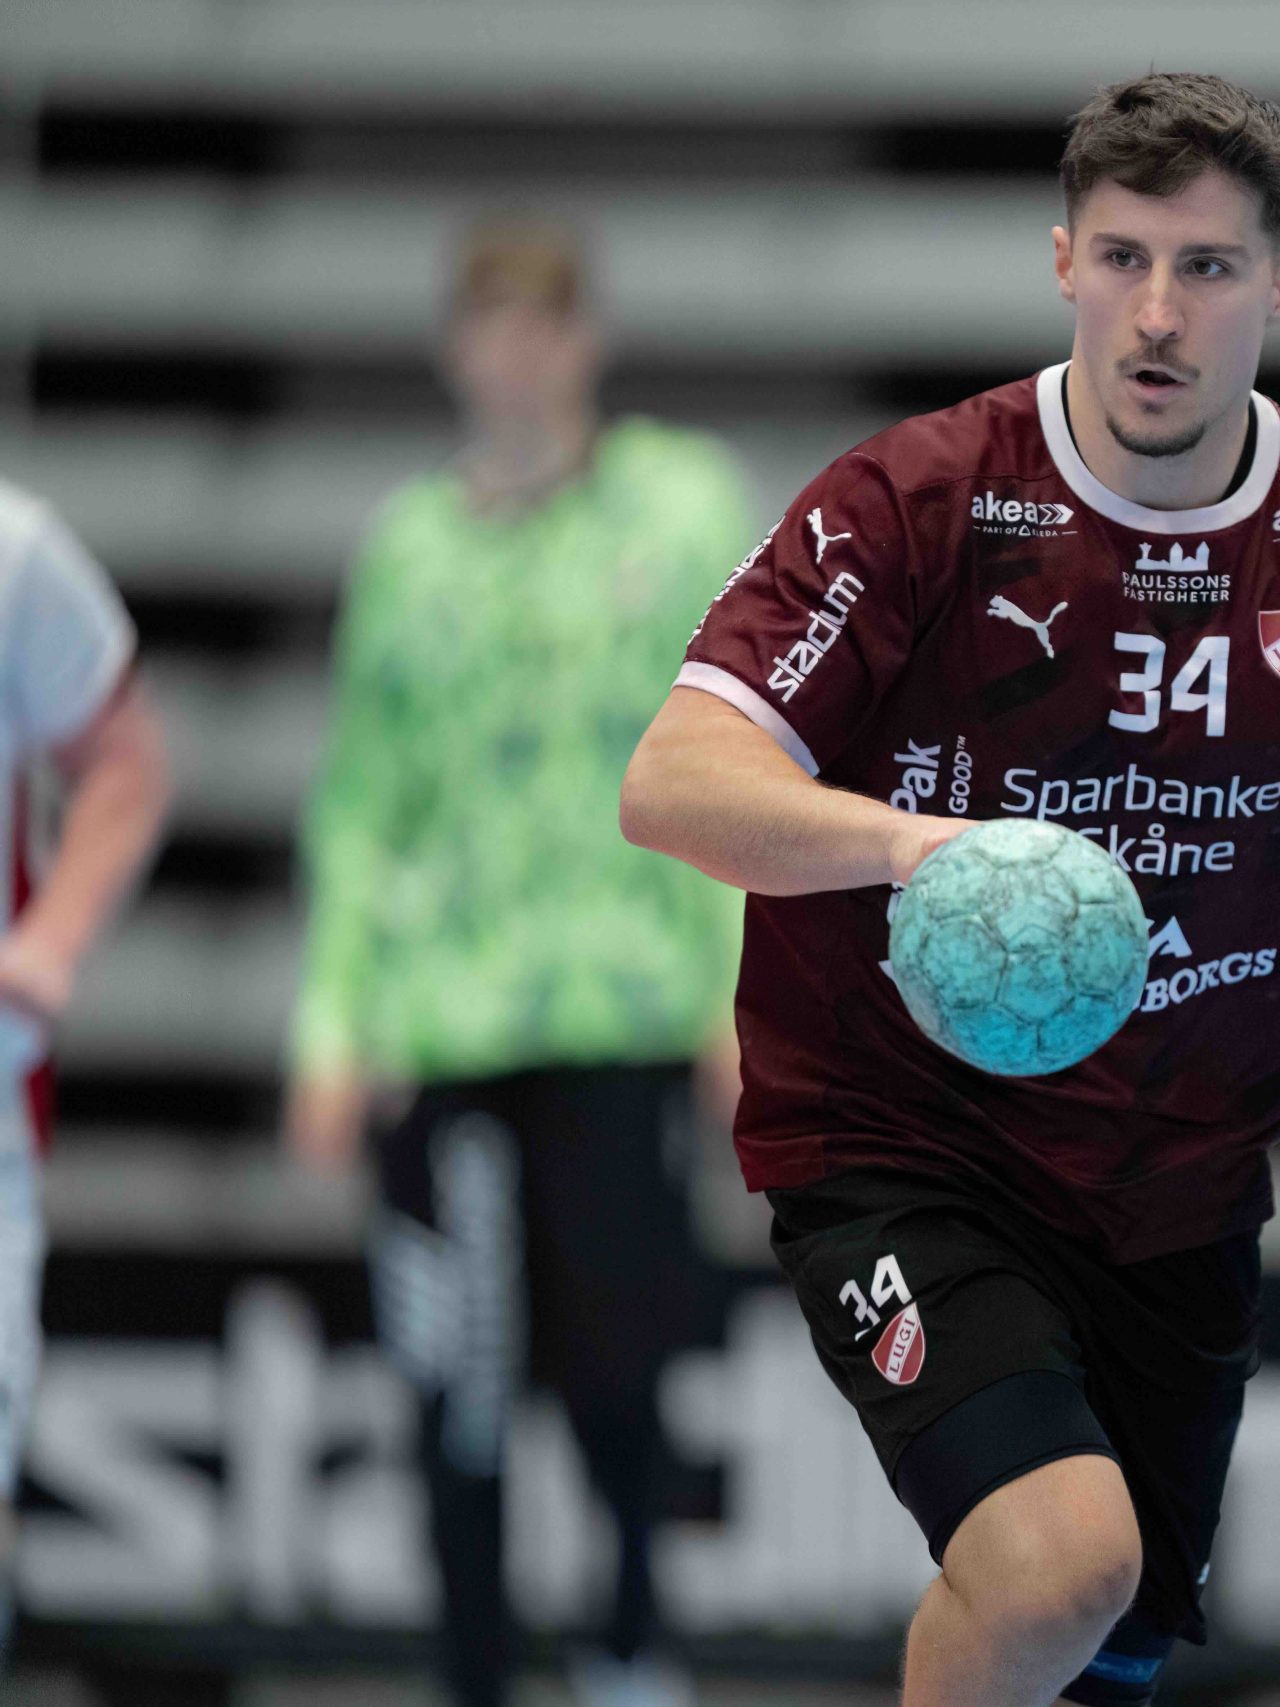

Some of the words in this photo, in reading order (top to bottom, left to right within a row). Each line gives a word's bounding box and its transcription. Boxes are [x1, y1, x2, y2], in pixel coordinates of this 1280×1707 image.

[971, 490, 1038, 524] akea
[1005, 526, 1017, 535] OF
[1122, 571, 1231, 590] PAULSSONS
[1124, 586, 1230, 603] FASTIGHETER
[766, 571, 866, 703] stadum
[1108, 631, 1230, 738] 34
[1078, 823, 1236, 876] kåne
[1132, 948, 1278, 1012] BORGS
[838, 1253, 913, 1342] 34
[889, 1318, 916, 1374] LUGI
